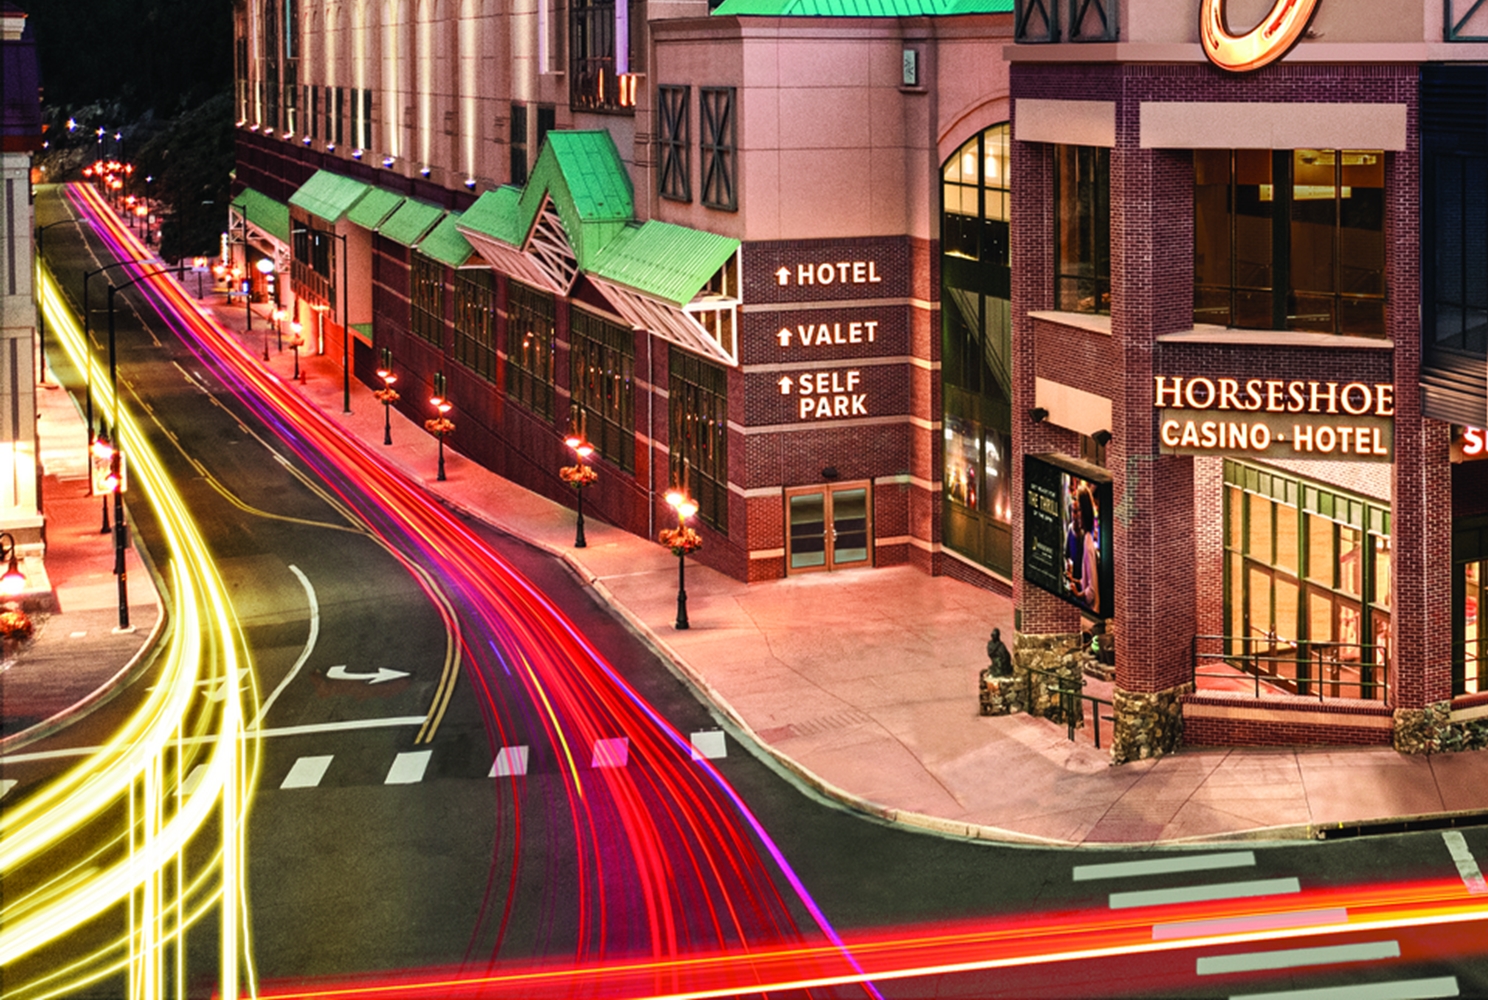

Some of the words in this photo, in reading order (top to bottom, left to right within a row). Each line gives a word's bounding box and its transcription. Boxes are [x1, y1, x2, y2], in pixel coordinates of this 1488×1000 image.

[798, 261, 881, 285] HOTEL
[798, 321, 878, 346] VALET
[799, 371, 860, 395] SELF
[1154, 376, 1394, 415] HORSESHOE
[799, 394, 867, 419] PARK
[1161, 419, 1271, 450] CASINO
[1293, 424, 1388, 454] HOTEL
